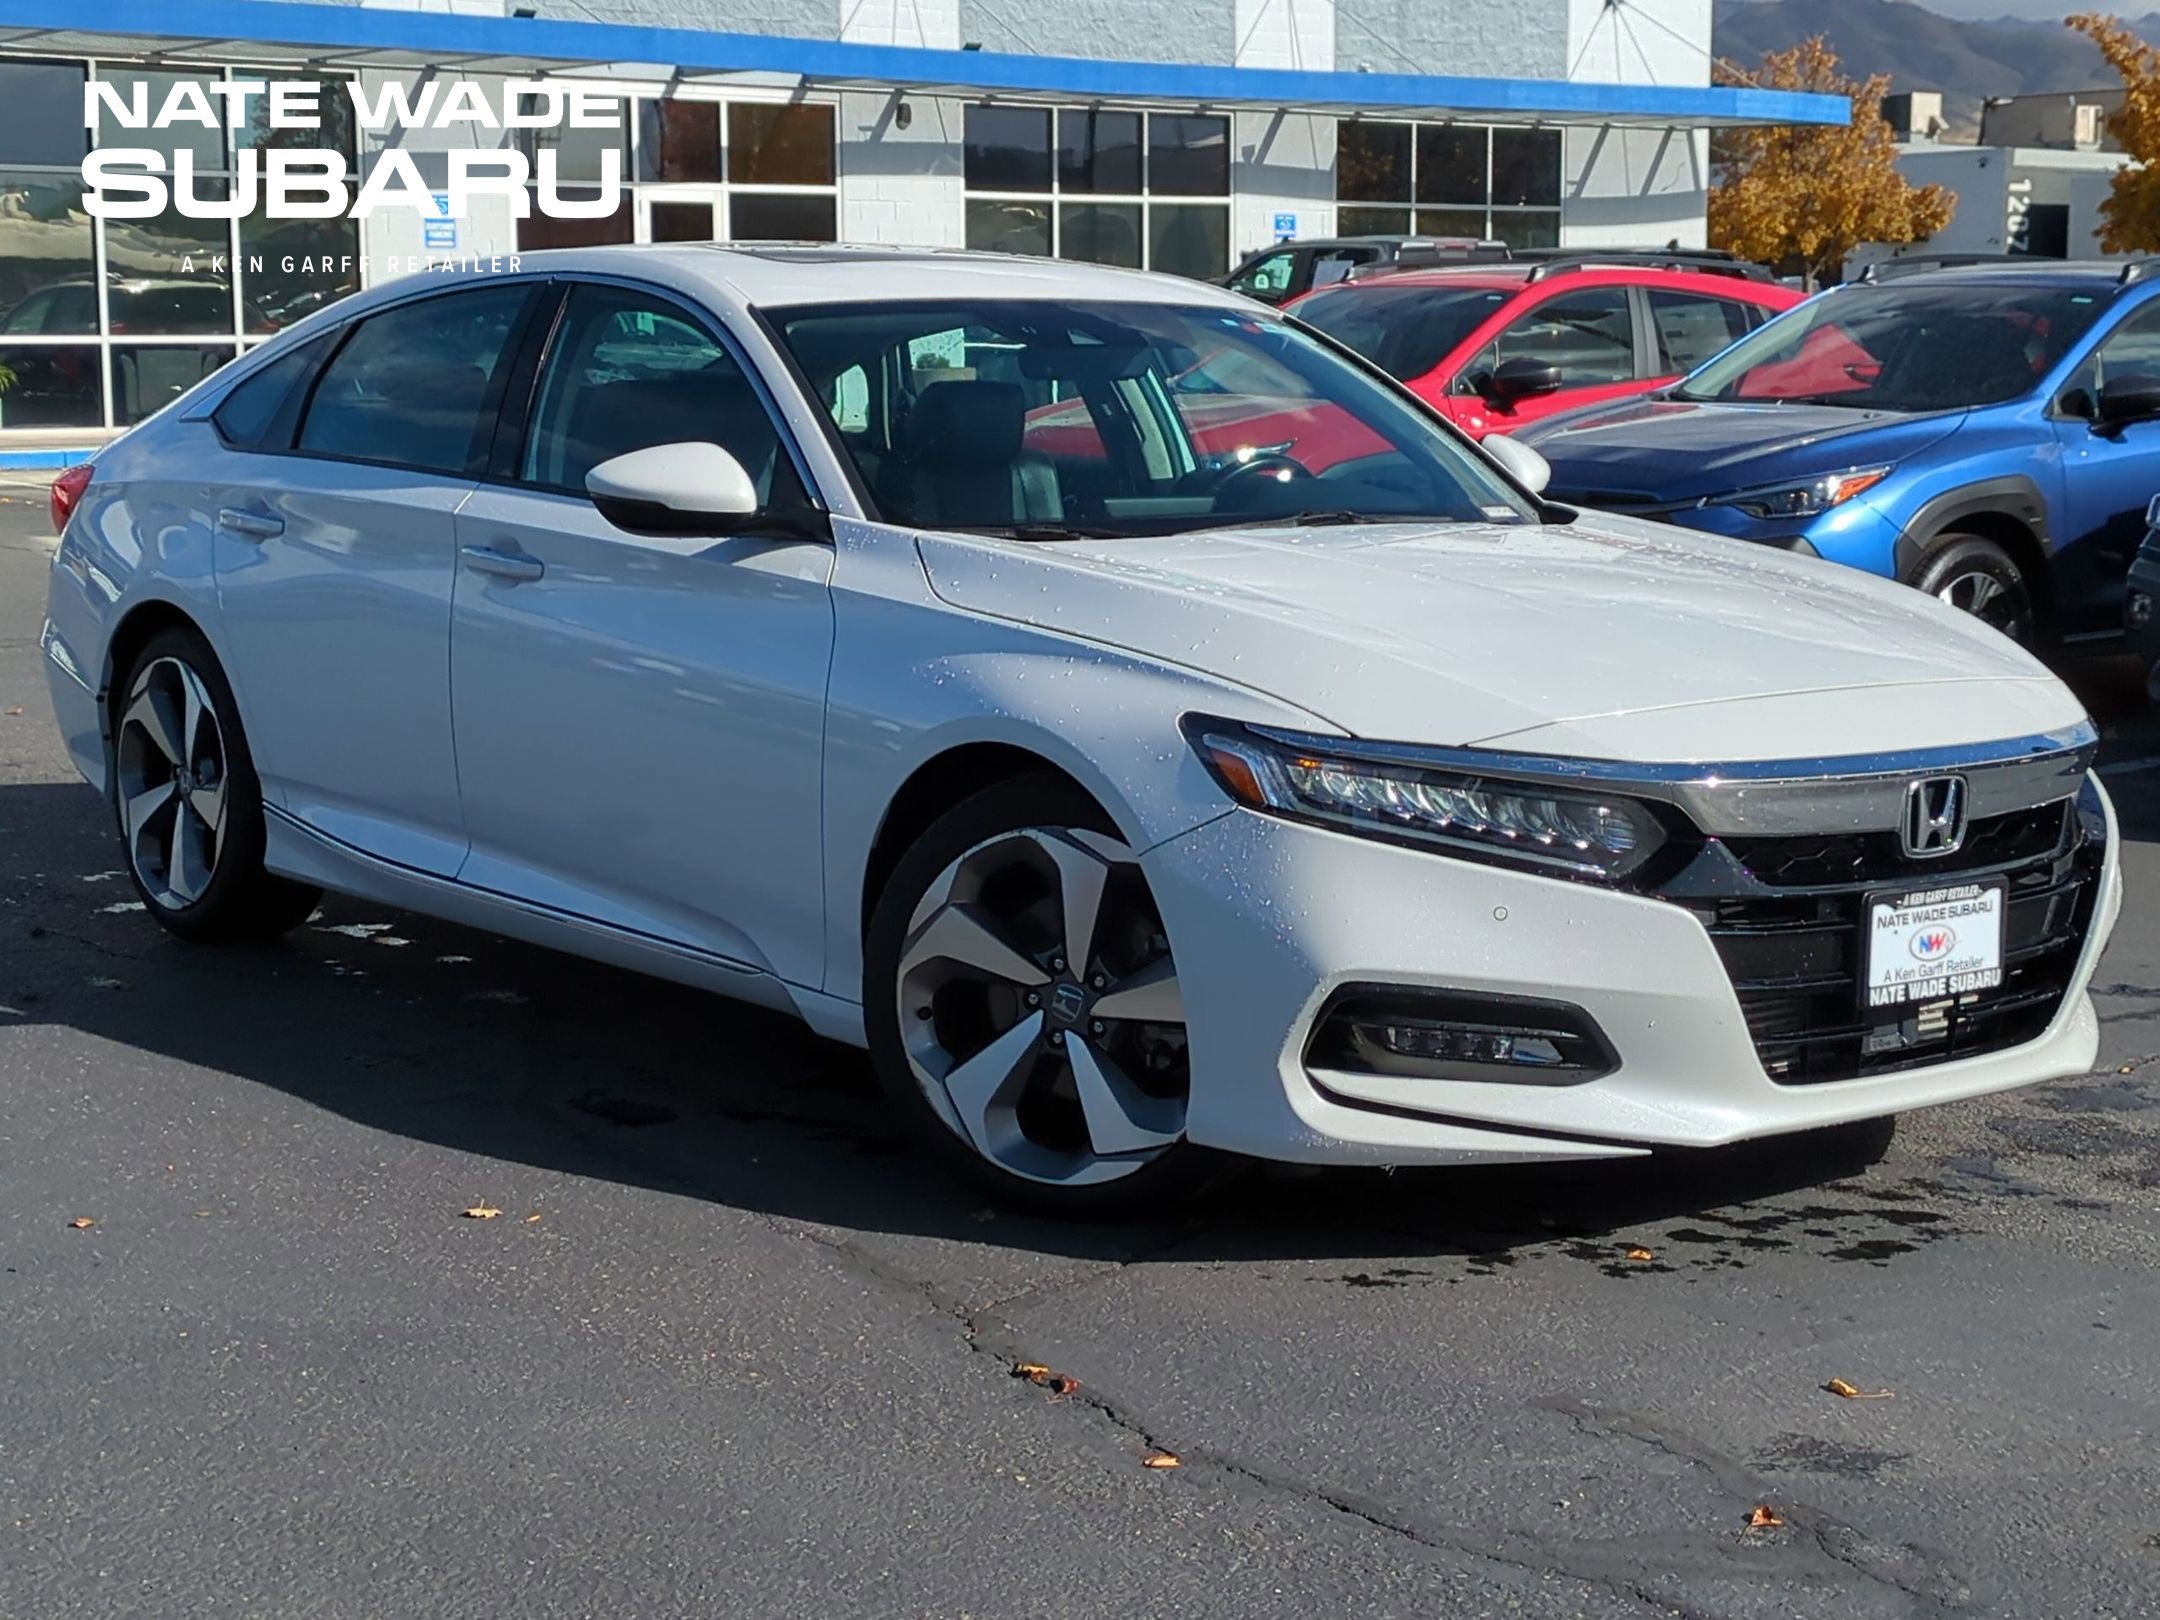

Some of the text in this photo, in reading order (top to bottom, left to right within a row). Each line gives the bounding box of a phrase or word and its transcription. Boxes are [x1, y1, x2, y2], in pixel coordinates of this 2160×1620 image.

[2007, 178, 2032, 251] 1207
[1877, 900, 1993, 929] NATE WADE SUBARU
[1884, 956, 1984, 983] A Ken Garff Retailer
[1869, 968, 2001, 1007] NATE WADE SUBARU
